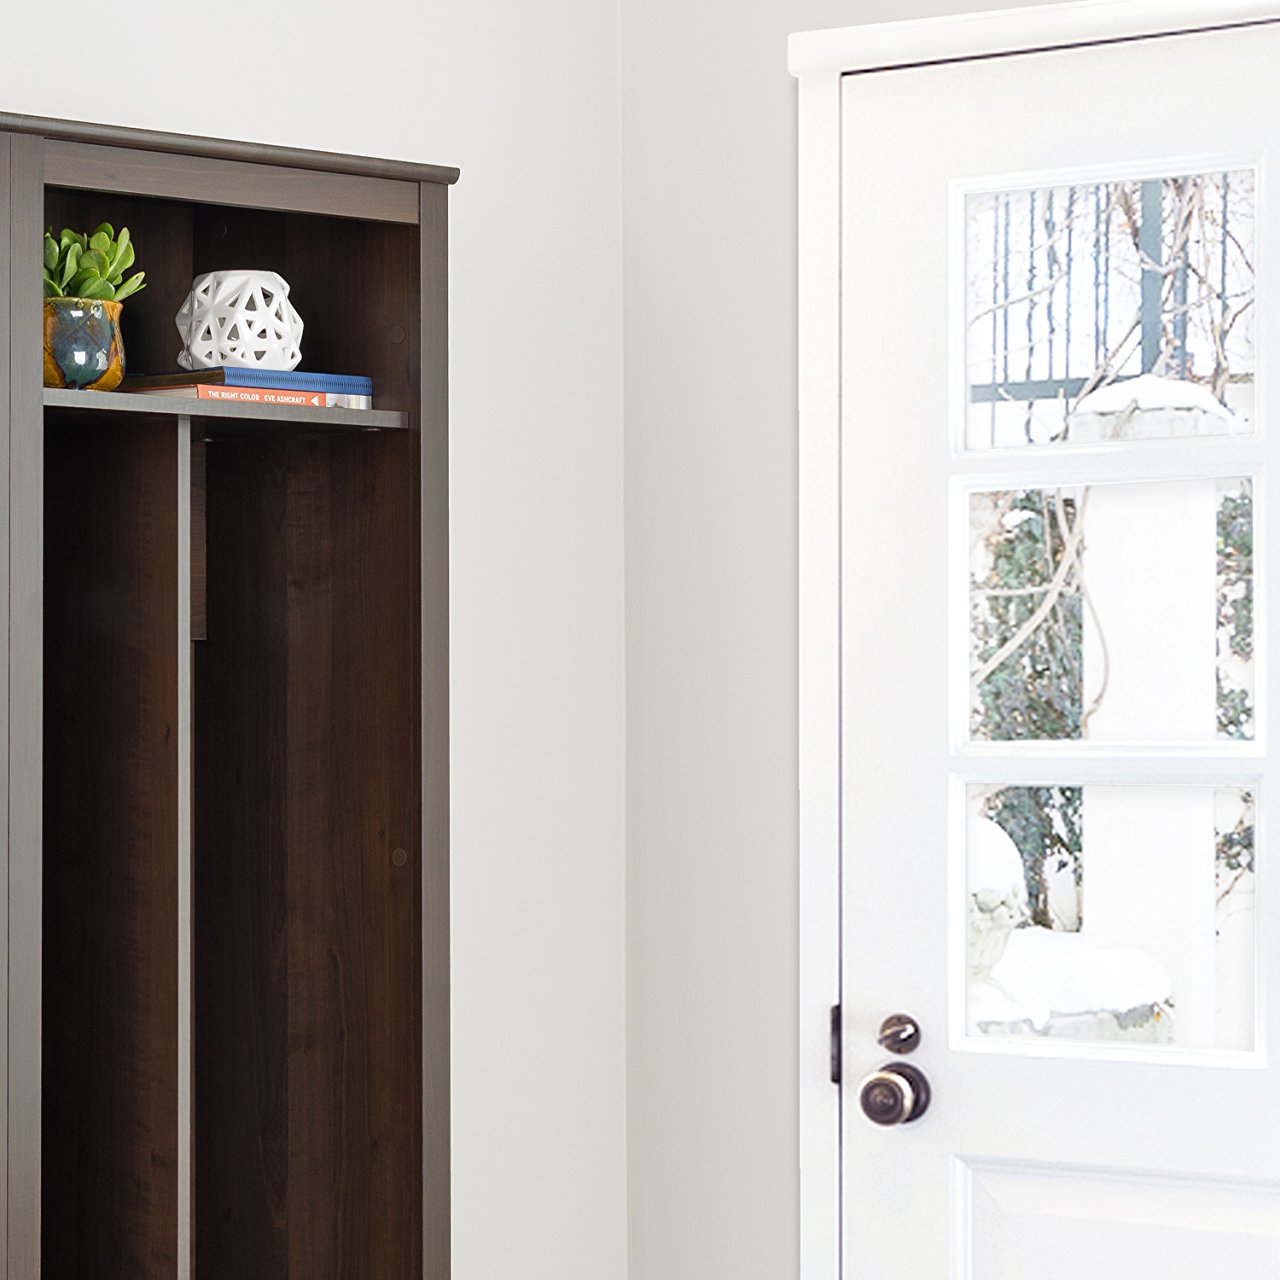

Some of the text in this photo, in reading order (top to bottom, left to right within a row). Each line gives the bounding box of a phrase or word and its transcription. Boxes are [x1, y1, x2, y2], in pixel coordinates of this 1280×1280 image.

[208, 391, 260, 401] THE RIGHT COLOR
[264, 394, 307, 404] EVE ASHCRAFT
